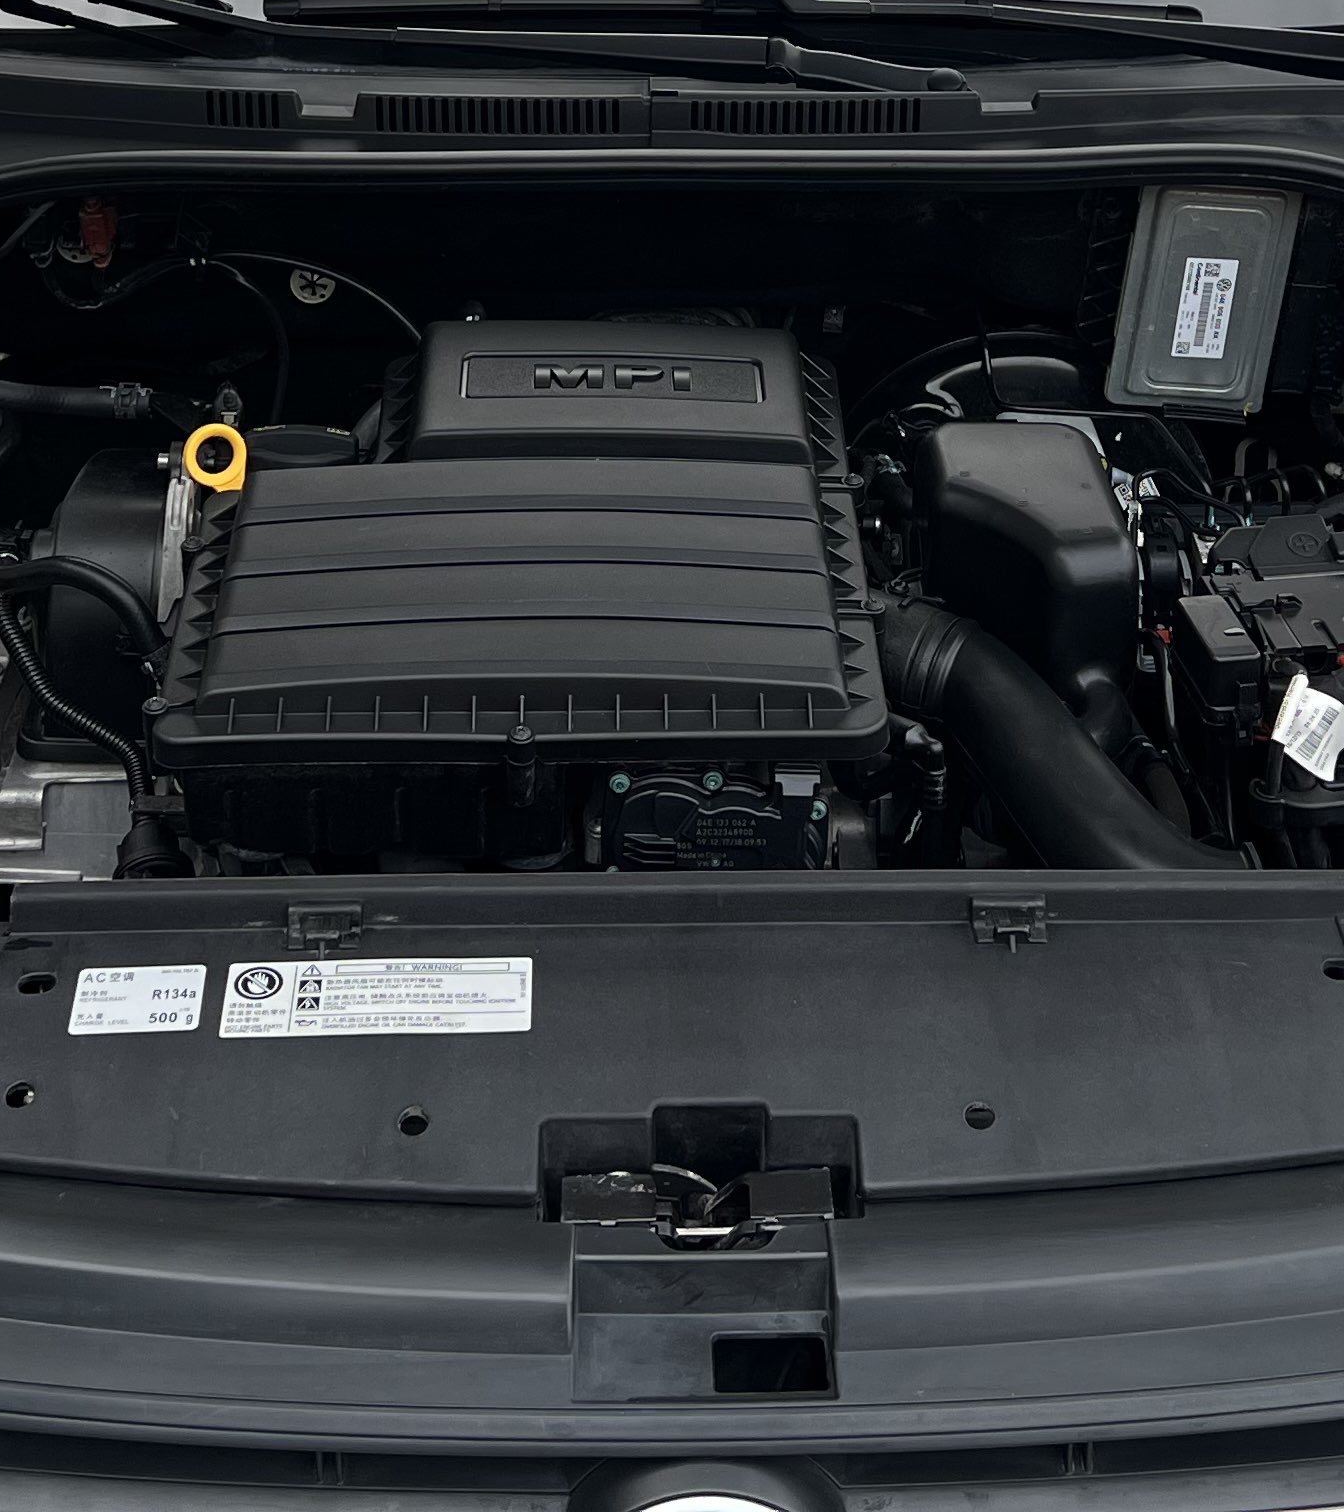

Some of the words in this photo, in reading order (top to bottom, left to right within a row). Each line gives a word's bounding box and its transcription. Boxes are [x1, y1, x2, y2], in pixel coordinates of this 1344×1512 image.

[534, 363, 693, 392] MPI
[152, 988, 196, 1000] R134a
[148, 1012, 178, 1024] 500
[185, 1014, 194, 1025] g
